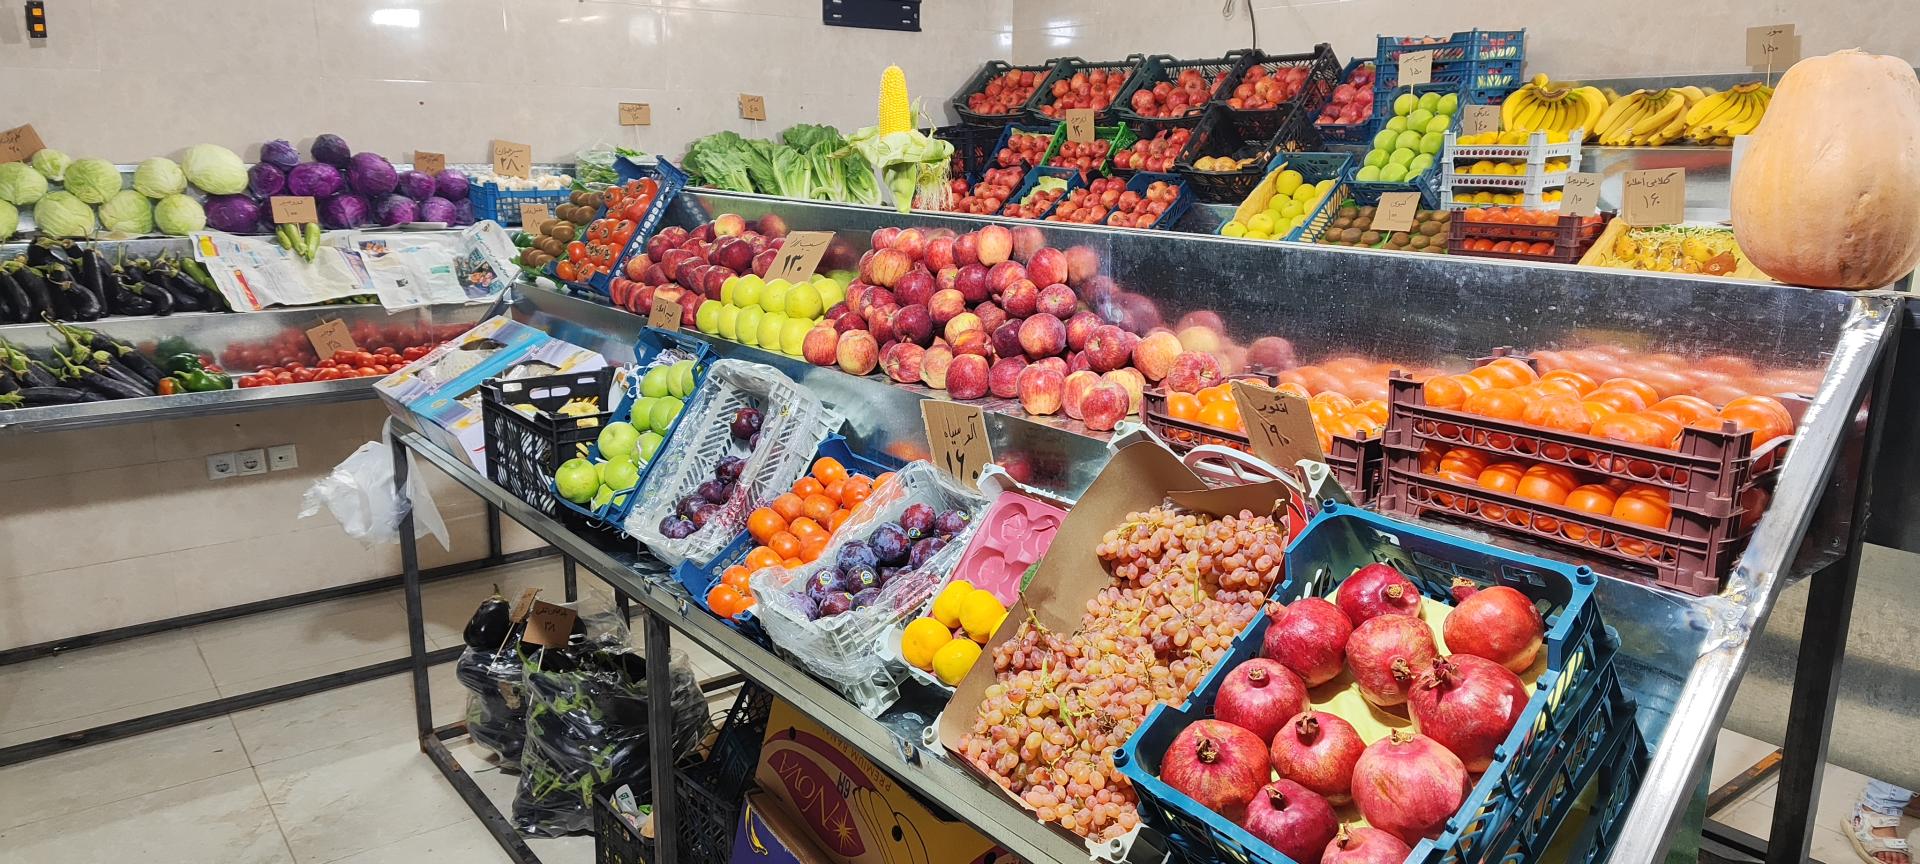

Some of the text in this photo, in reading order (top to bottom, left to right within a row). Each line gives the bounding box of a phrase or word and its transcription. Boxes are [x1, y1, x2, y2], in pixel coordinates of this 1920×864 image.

[500, 156, 525, 172] ۲۸۰
[1642, 192, 1661, 209] ۱۶۰
[780, 253, 805, 278] ۱۳۰
[1260, 422, 1290, 447] ۱۹۰
[849, 746, 893, 794] PREMIUM
[778, 752, 841, 832] NOVA
